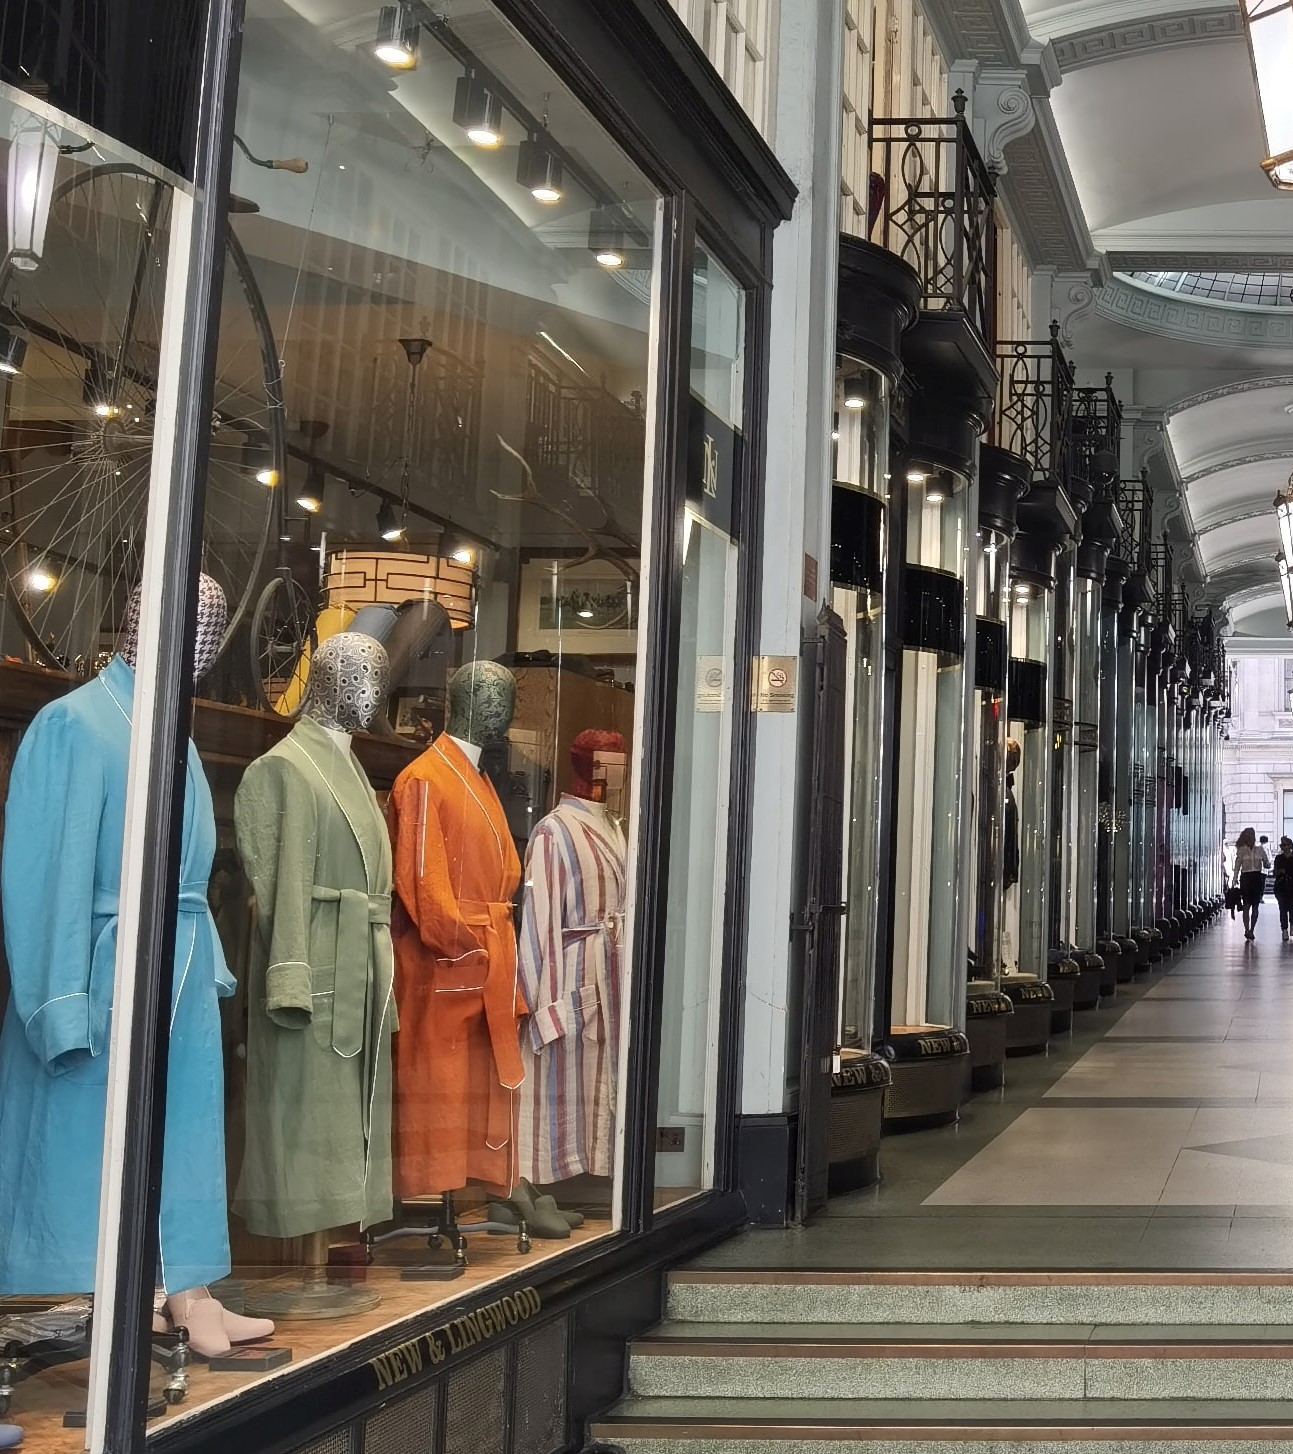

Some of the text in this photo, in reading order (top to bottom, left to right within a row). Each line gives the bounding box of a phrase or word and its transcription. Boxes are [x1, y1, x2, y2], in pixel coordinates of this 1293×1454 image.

[918, 1038, 951, 1055] NEW
[369, 1286, 542, 1391] NEW & LINGWOOD
